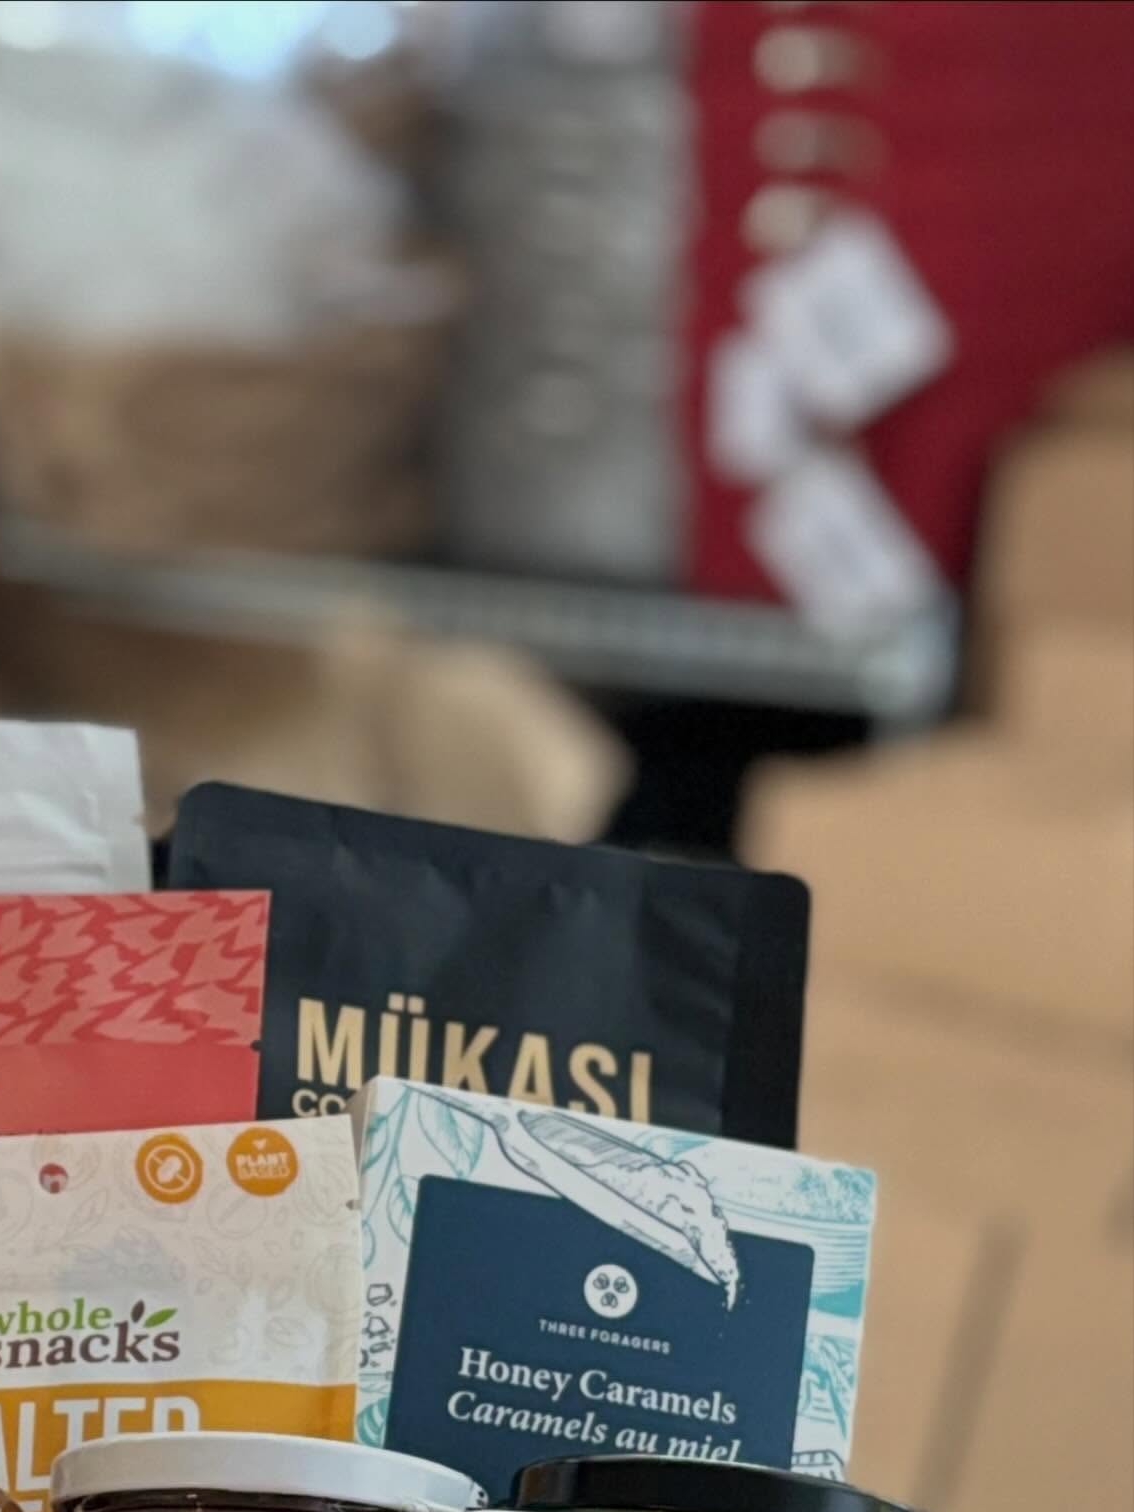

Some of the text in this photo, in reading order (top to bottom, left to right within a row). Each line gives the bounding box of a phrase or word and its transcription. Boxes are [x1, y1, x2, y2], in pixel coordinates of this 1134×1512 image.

[298, 992, 652, 1125] MÜKASI
[291, 1088, 346, 1118] CO
[235, 1152, 289, 1168] PLANT
[538, 1318, 672, 1355] THREE FORAGERS
[458, 1346, 738, 1426] Honey Caramels
[447, 1389, 742, 1463] Caramels au miel
